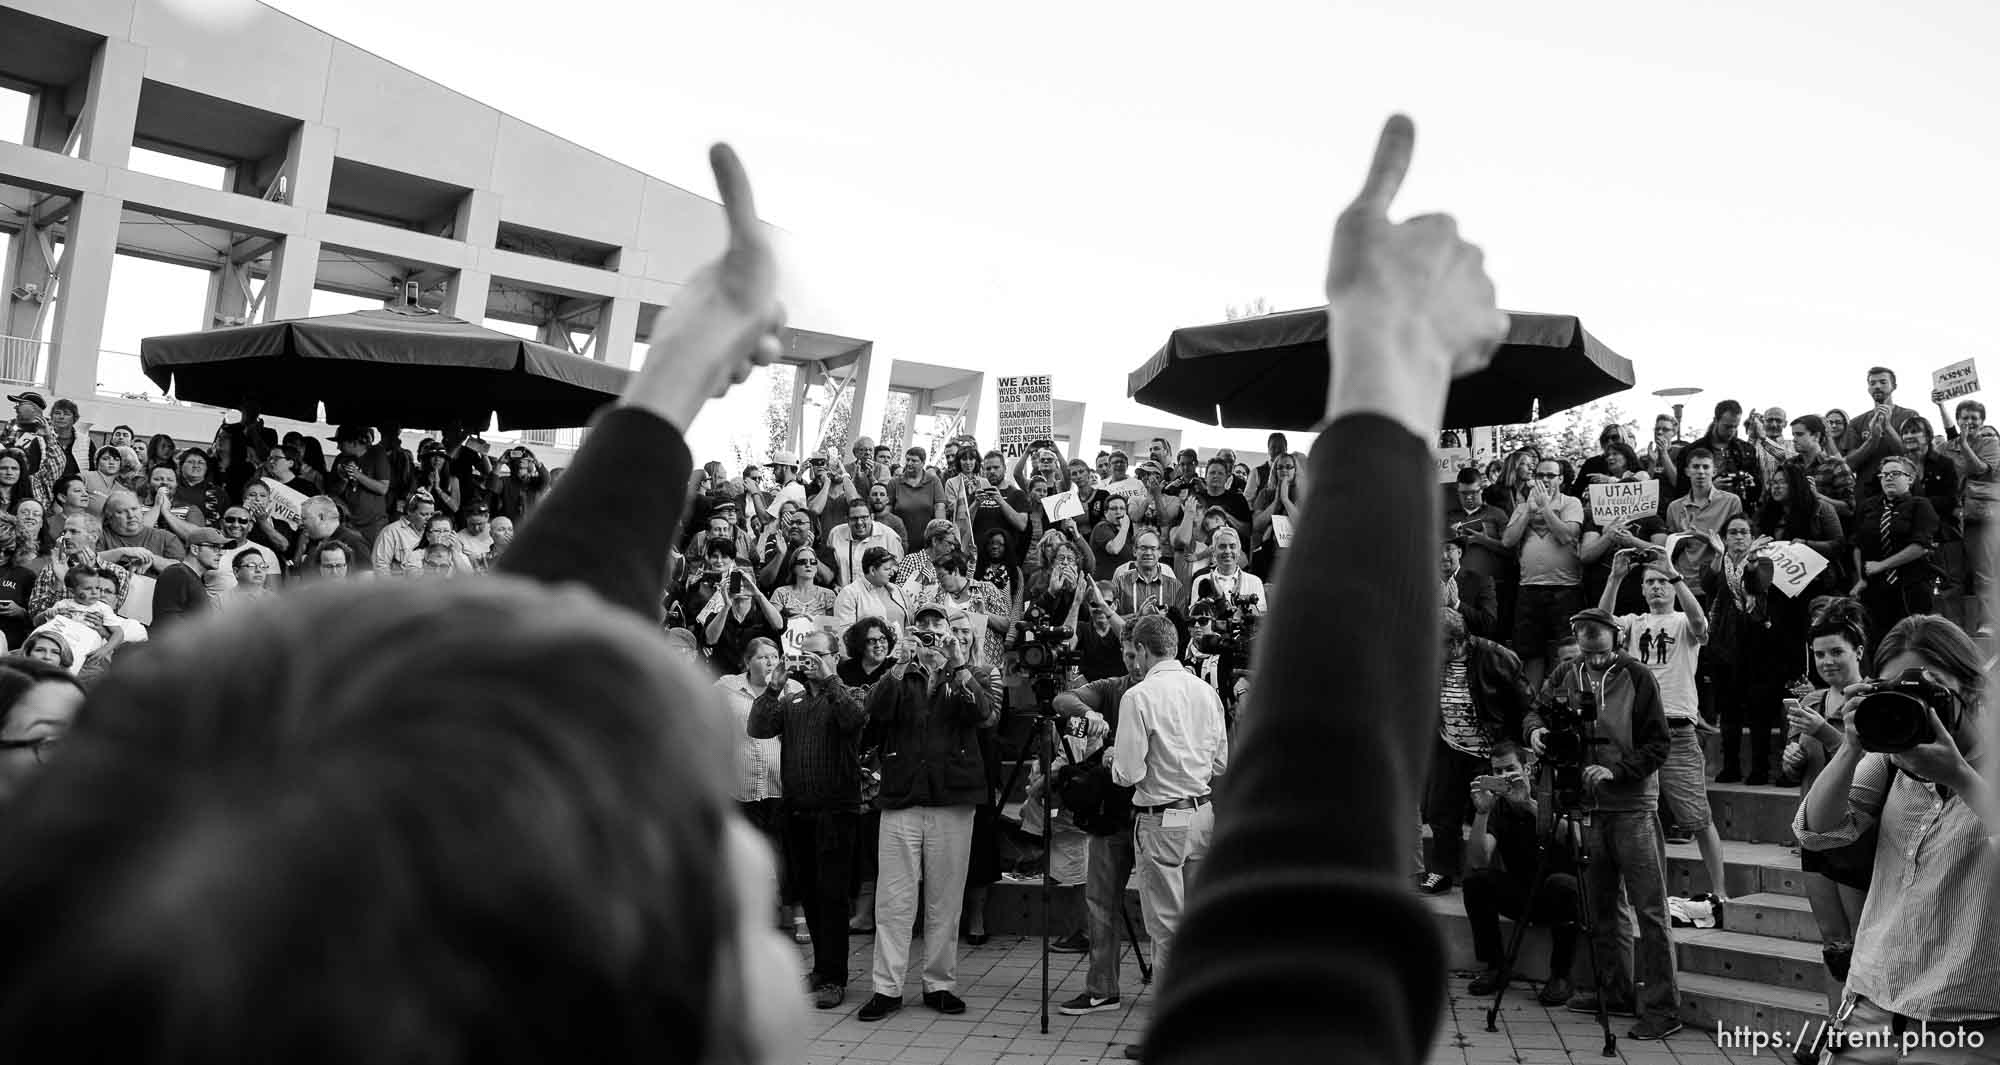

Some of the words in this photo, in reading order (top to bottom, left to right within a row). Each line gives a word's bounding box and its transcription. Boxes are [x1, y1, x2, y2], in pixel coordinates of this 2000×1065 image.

[998, 377, 1017, 387] WE
[1021, 376, 1050, 386] ARE:
[998, 387, 1017, 395] WIVES
[1018, 385, 1051, 394] HUSBANDS
[999, 395, 1021, 403] DADS
[1025, 394, 1051, 403] MOMS
[999, 410, 1051, 418] GRANDMOTHERS
[1000, 427, 1023, 435] AUNTS
[1024, 426, 1052, 434] UNCLES
[1000, 435, 1021, 443] NIECES
[1022, 434, 1052, 442] NEPHEWS
[1605, 483, 1642, 498] UTAH
[1594, 500, 1657, 516] MARRIAGE
